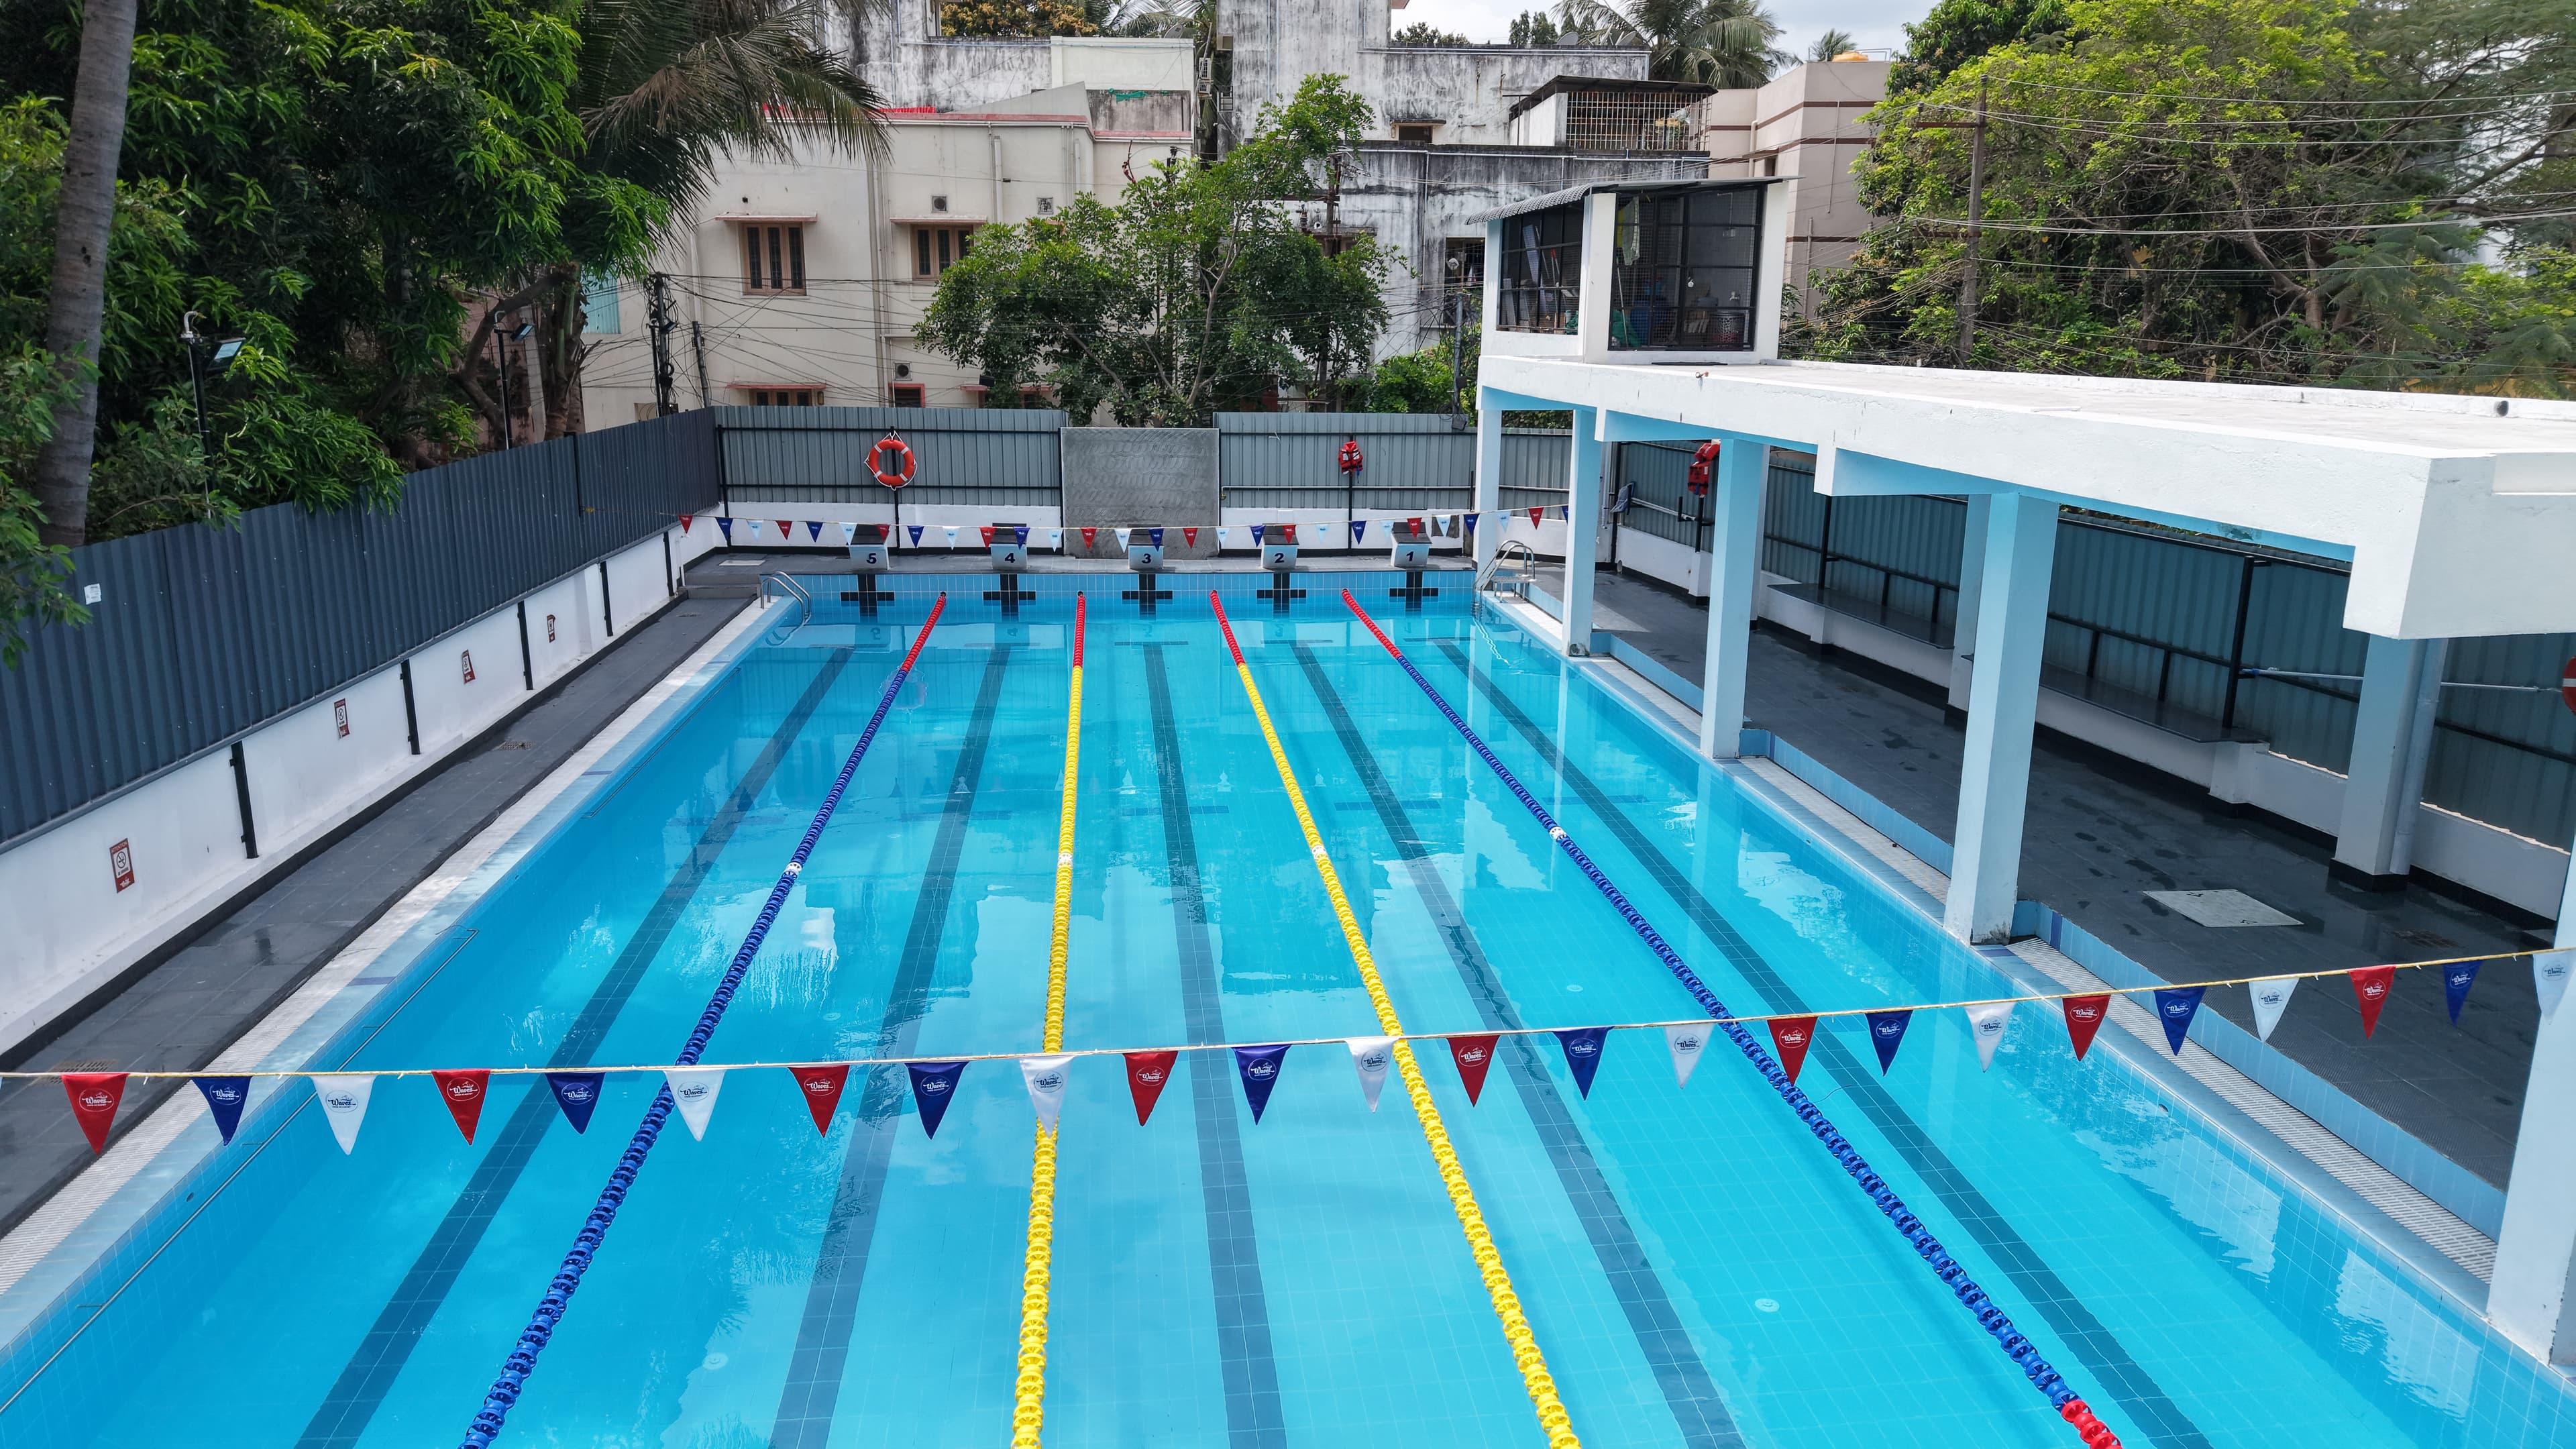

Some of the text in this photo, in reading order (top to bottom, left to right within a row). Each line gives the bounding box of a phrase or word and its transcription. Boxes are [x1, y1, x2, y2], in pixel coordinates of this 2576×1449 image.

[866, 552, 877, 564] 5
[1004, 552, 1016, 564] 4
[1141, 553, 1152, 564] 3
[1274, 552, 1285, 564] 2
[1406, 551, 1414, 562] 1
[1460, 1052, 1486, 1060] Waves
[449, 1085, 478, 1093] Waves
[806, 1081, 833, 1089] Waves
[212, 1089, 239, 1097] Waves
[82, 1096, 112, 1104] Waves
